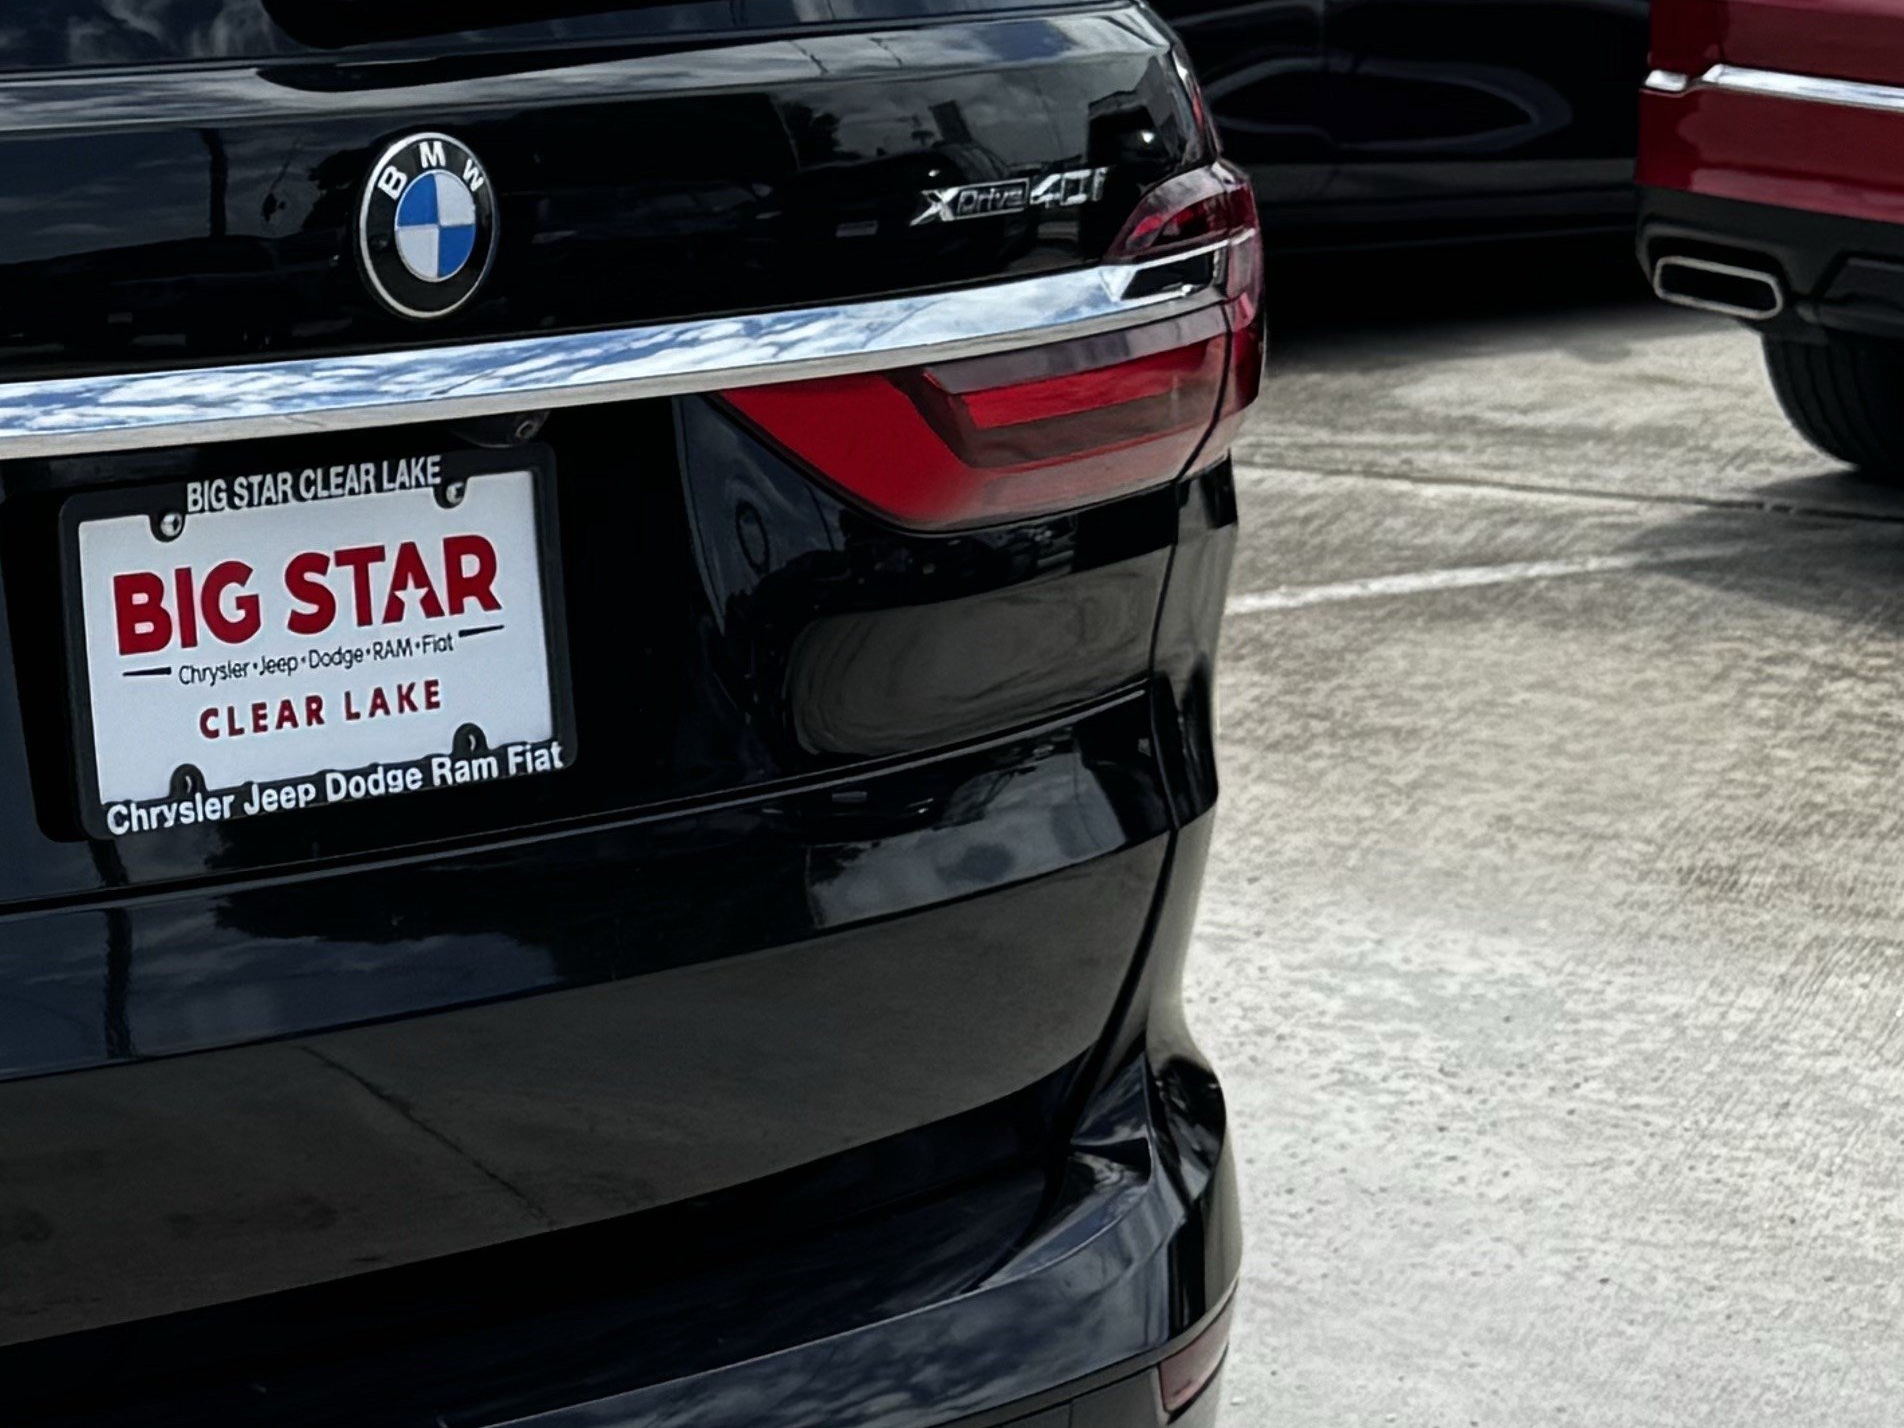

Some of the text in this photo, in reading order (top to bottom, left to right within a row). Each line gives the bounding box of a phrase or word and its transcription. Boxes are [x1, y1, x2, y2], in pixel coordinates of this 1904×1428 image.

[377, 141, 484, 201] BMW
[187, 455, 441, 513] BIG STAR CLEAR LAKE
[113, 534, 502, 655] BIG STAR
[199, 679, 441, 739] CLEAR LAKE
[106, 740, 563, 837] Chrysler Jeep Dodge Ram Fiat
